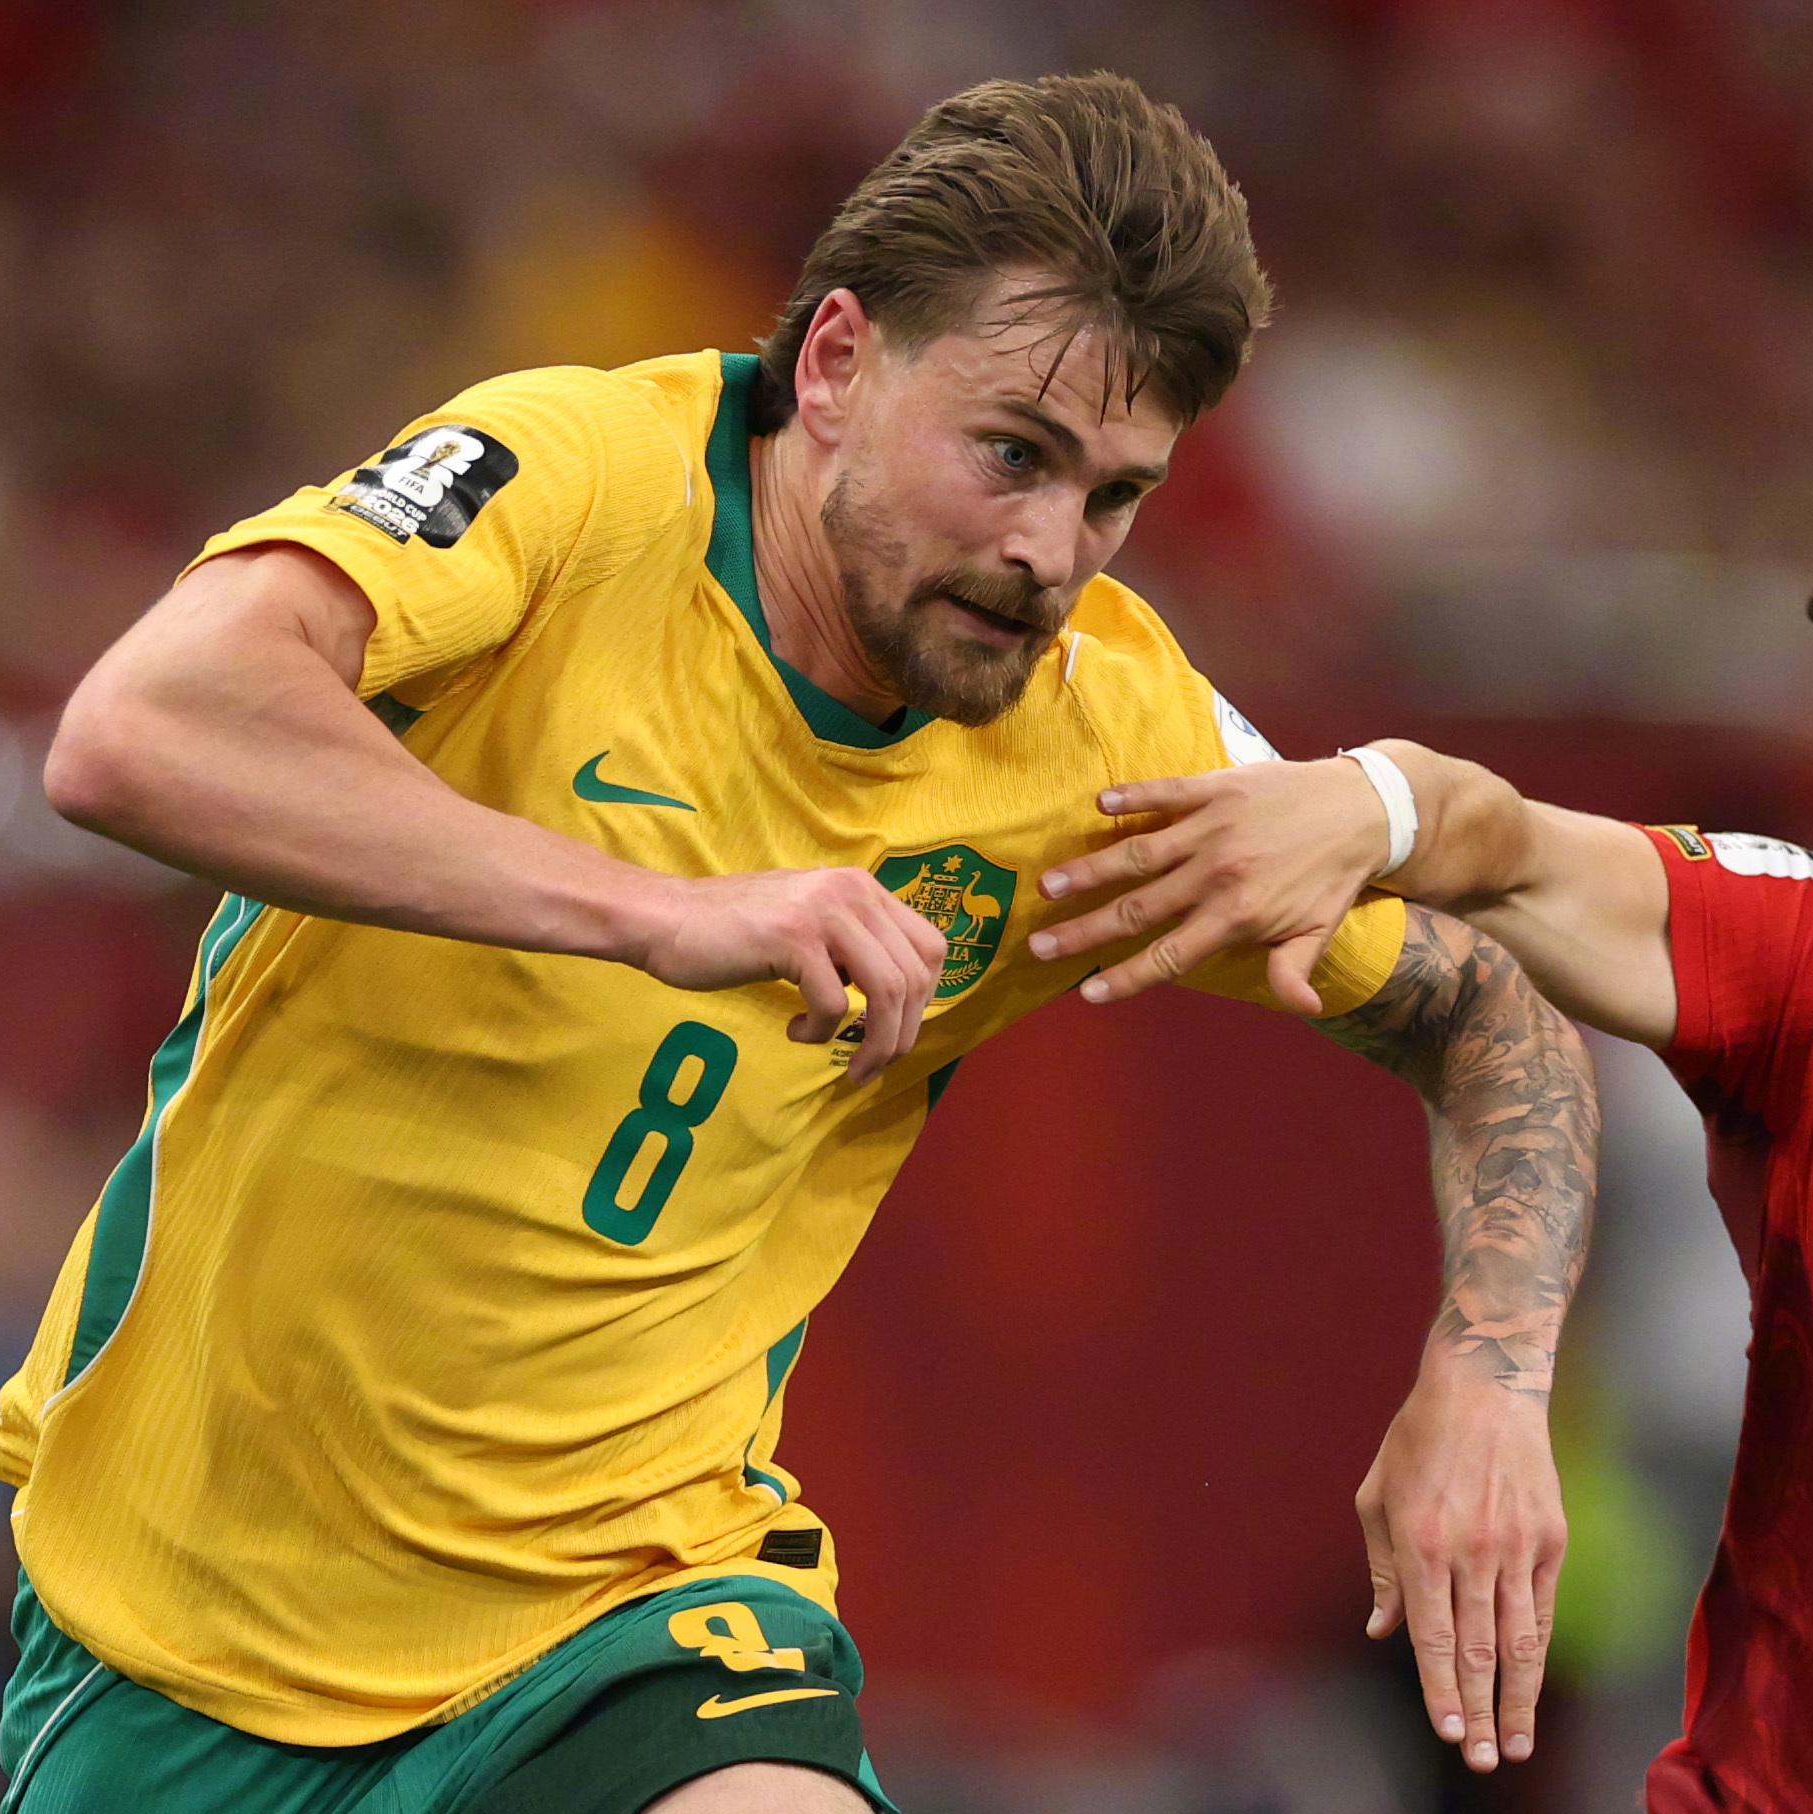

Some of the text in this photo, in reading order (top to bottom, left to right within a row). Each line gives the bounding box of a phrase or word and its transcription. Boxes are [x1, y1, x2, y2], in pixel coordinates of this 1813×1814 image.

[398, 475, 425, 495] FIFA
[362, 495, 420, 534] 2026
[405, 503, 427, 521] CUP
[582, 1020, 738, 1246] 8
